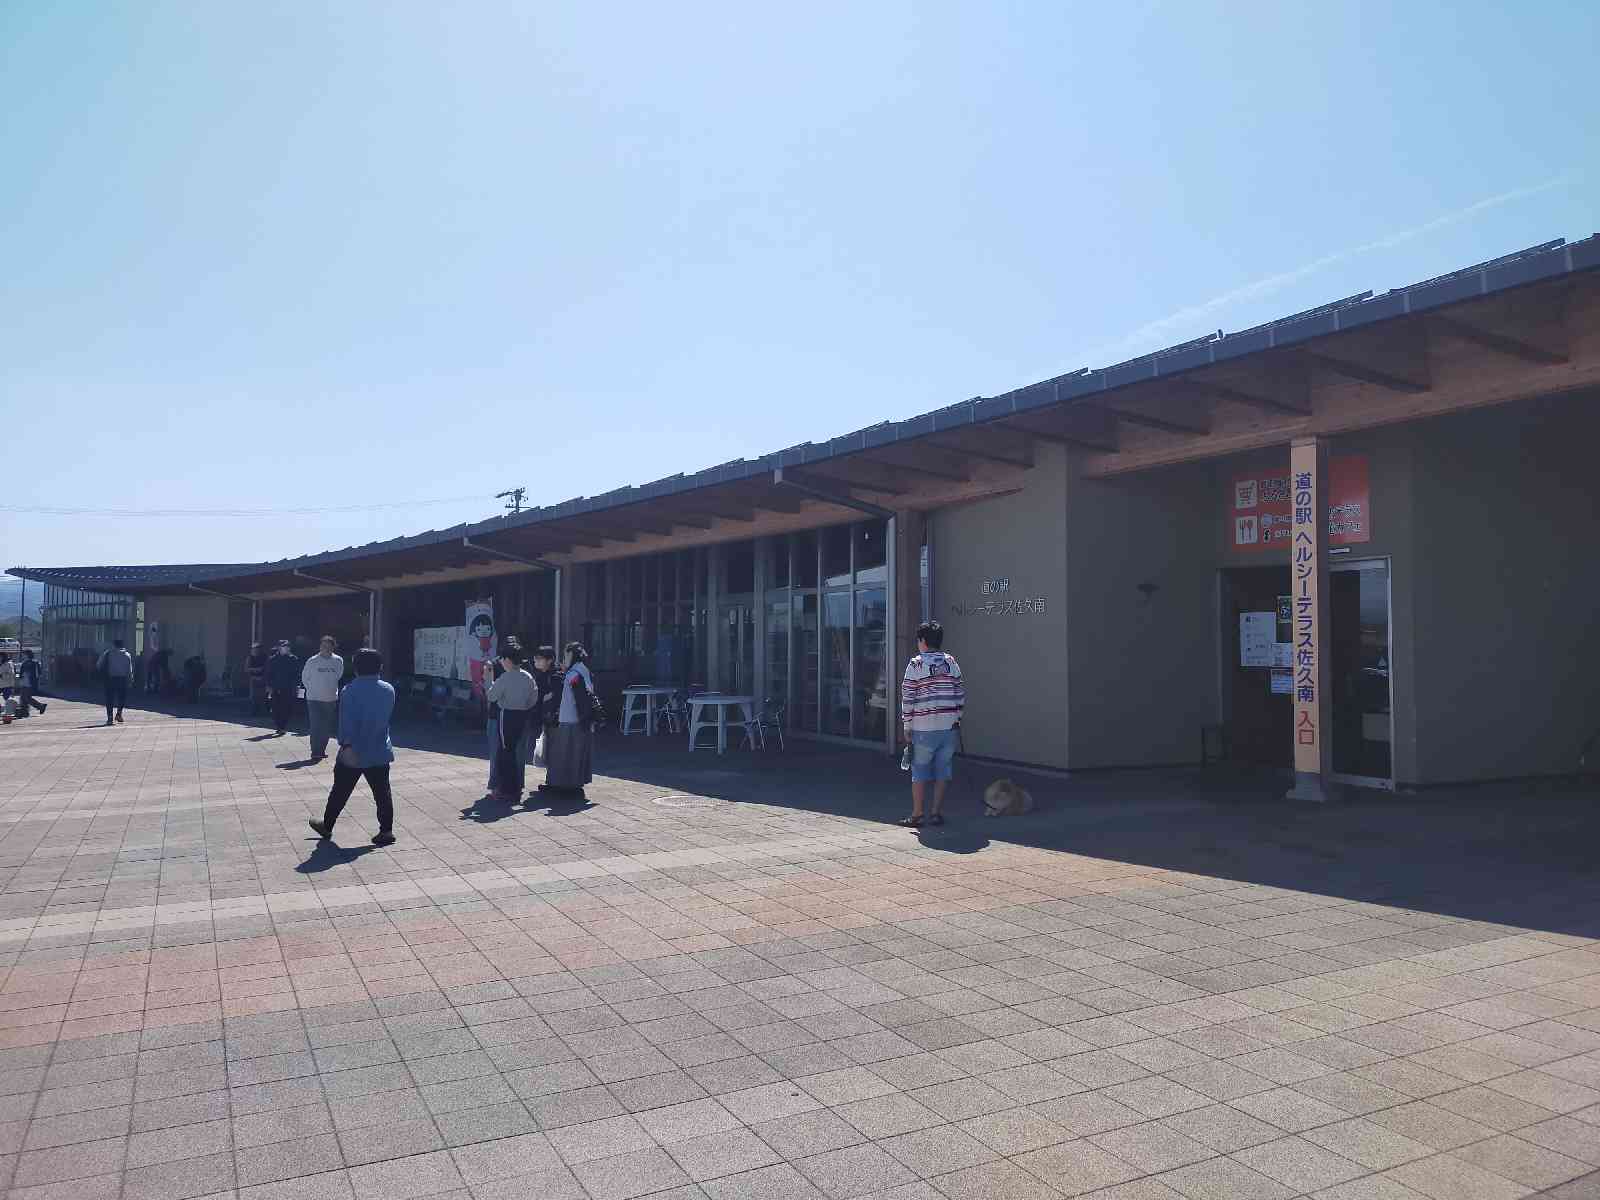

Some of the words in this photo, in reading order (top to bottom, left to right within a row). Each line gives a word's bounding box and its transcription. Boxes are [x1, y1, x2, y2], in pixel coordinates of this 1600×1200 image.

[1296, 472, 1312, 524] 道の駅
[1296, 531, 1314, 702] ヘルシーテラス佐久南
[1298, 710, 1315, 745] 入口
